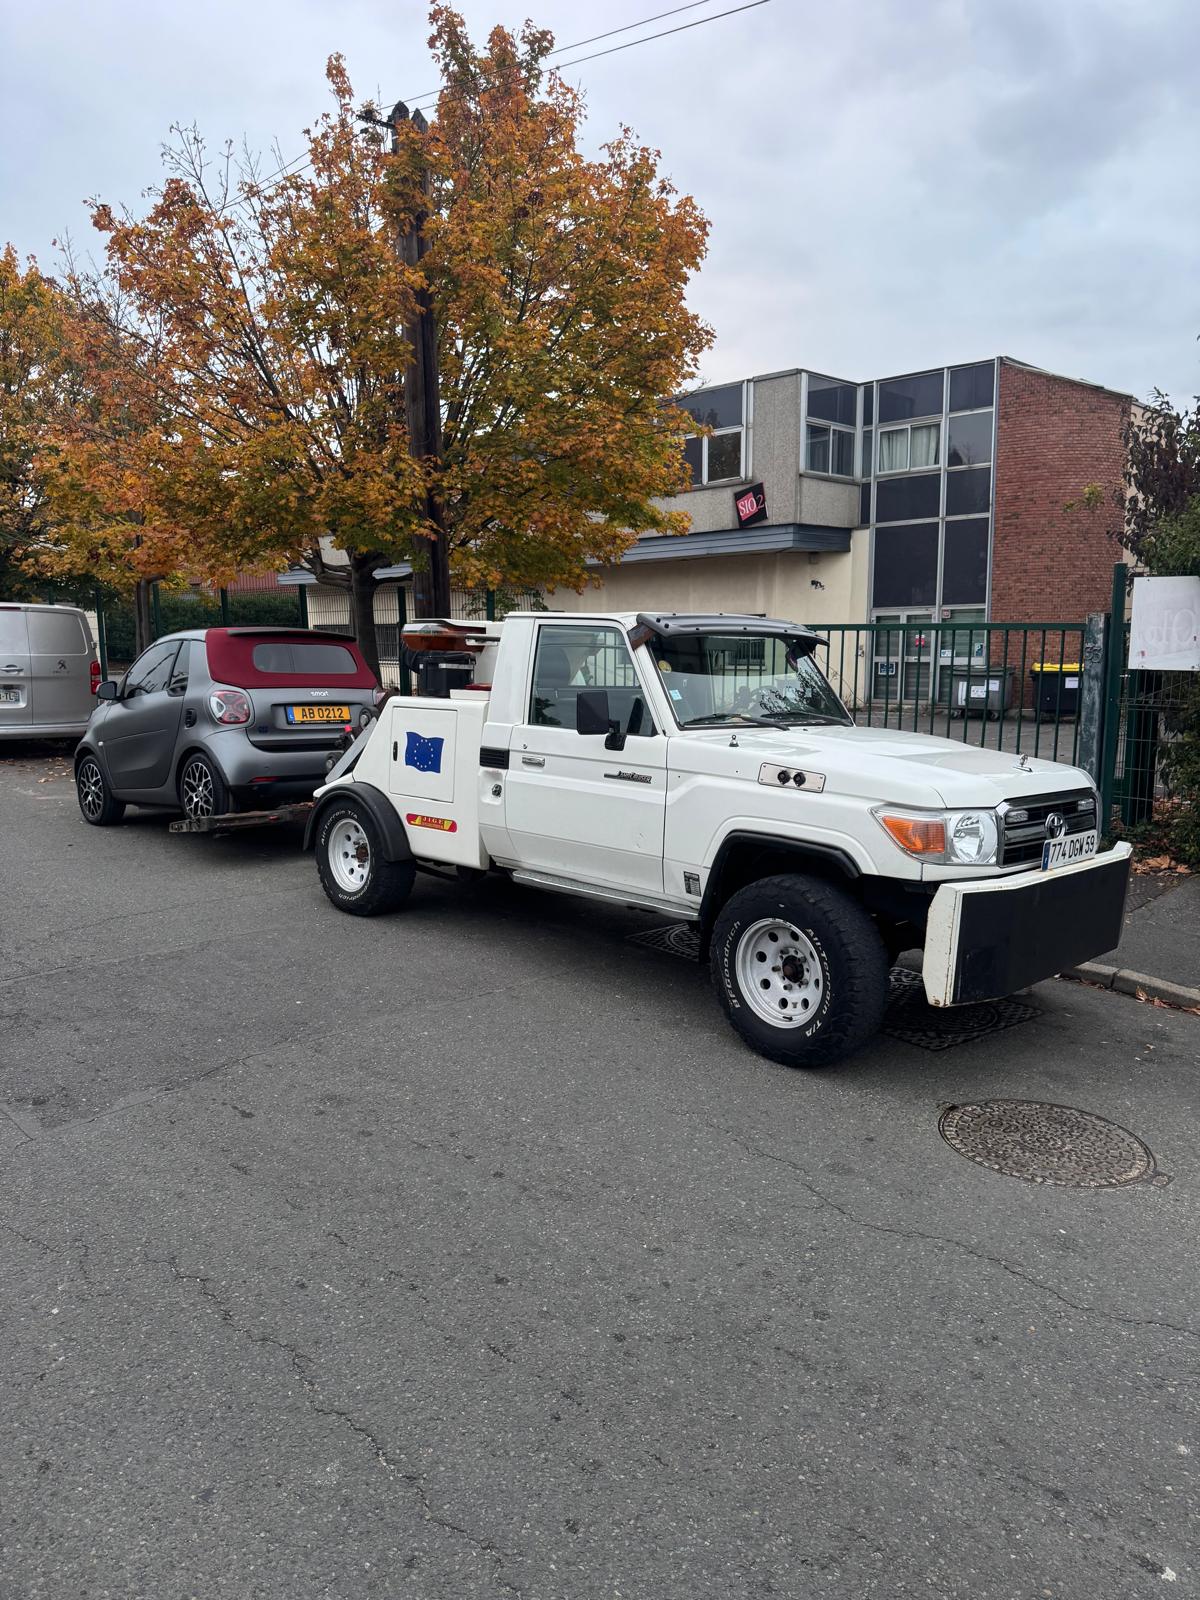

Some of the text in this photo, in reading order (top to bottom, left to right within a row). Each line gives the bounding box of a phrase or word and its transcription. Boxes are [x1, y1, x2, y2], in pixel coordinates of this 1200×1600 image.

[301, 707, 345, 719] AB 0212
[1050, 840, 1067, 863] 774
[1085, 834, 1095, 854] 59
[805, 928, 831, 1037] All-Terrain T/A
